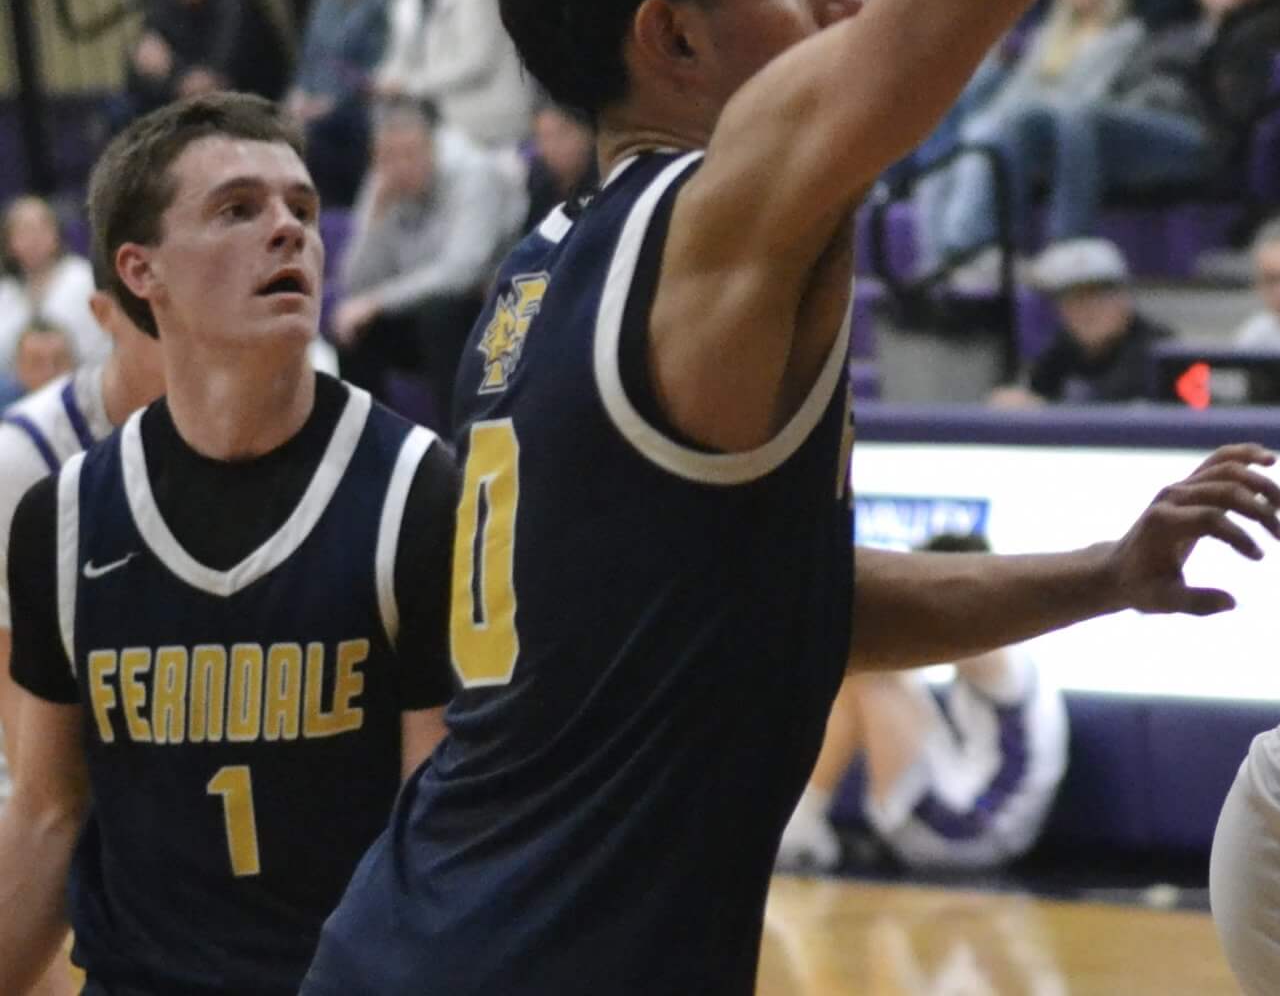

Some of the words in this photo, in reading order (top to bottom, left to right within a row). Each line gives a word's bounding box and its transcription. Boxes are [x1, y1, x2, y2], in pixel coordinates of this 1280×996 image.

[448, 416, 522, 688] 0
[87, 638, 370, 744] FERNDALE
[206, 765, 260, 877] 1
